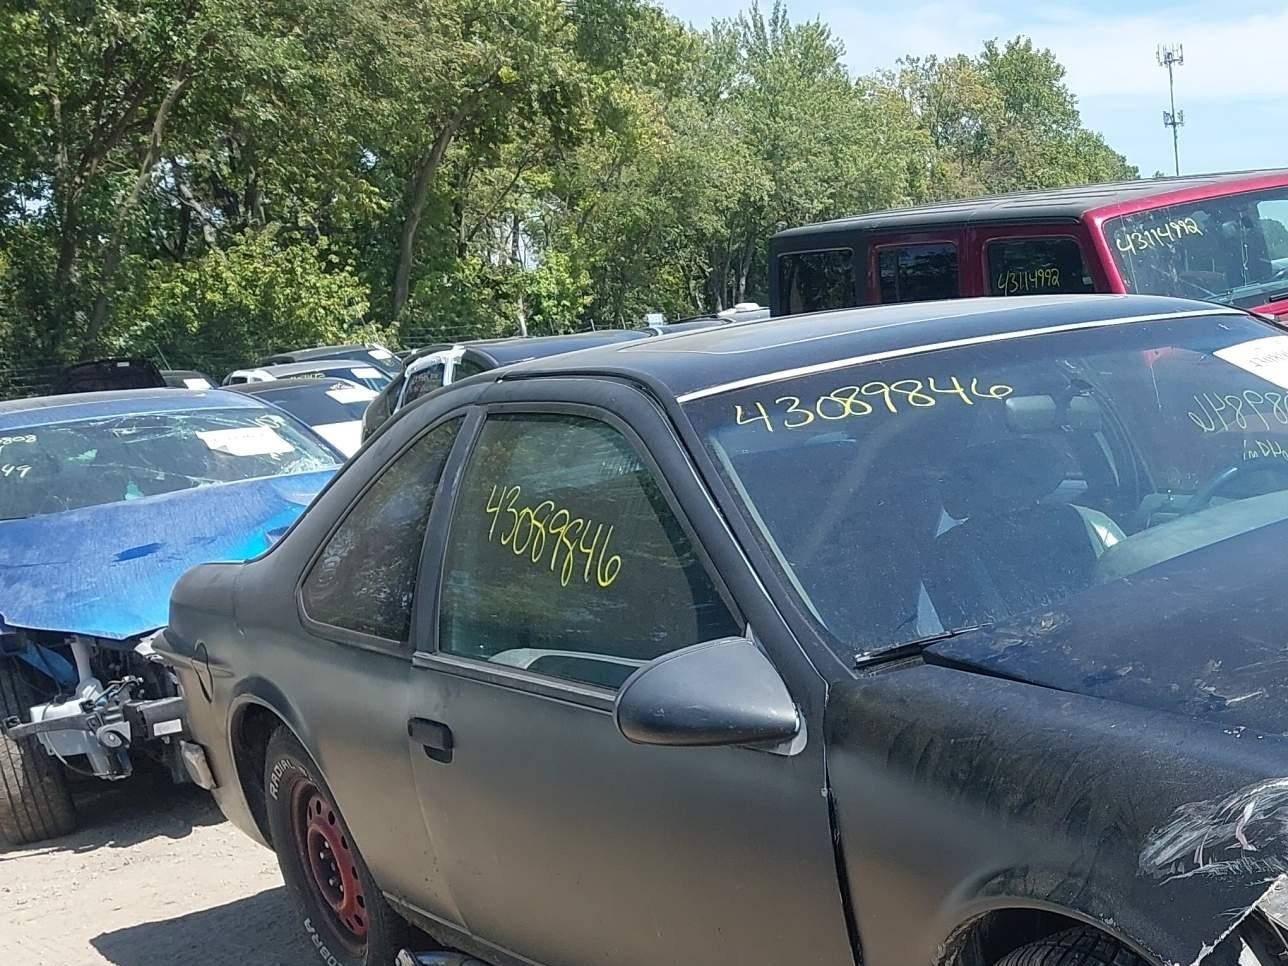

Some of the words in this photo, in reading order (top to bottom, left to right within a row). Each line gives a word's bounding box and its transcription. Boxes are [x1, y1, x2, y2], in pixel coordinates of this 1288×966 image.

[1116, 218, 1204, 256] 43114992
[998, 268, 1061, 297] 43114992
[735, 376, 1014, 433] 43089846
[486, 484, 622, 588] 43089846
[269, 759, 296, 801] RADIAL
